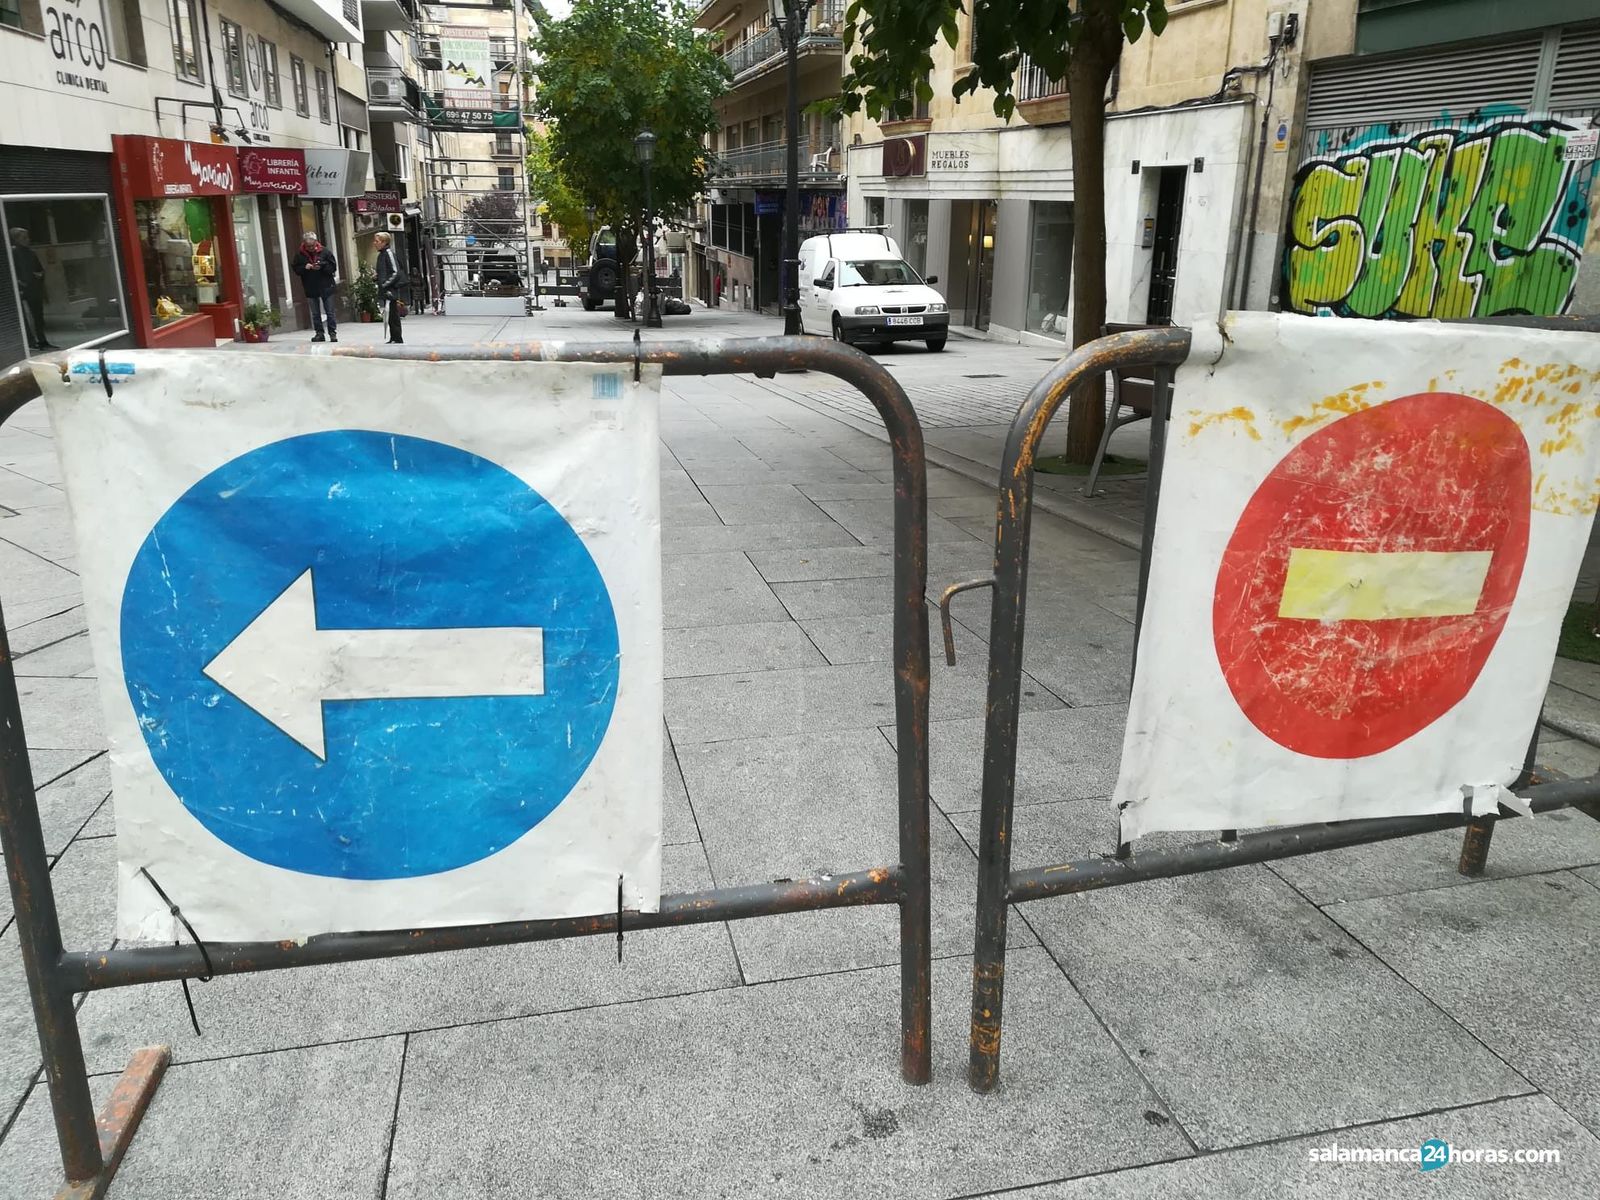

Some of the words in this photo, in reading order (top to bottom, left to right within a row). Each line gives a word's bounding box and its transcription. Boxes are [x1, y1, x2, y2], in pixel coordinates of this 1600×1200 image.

[46, 6, 105, 71] arco
[249, 101, 269, 131] arco
[461, 111, 471, 119] 47
[472, 112, 482, 120] 50
[483, 112, 493, 120] 75
[931, 150, 970, 159] MUEBLES
[931, 160, 969, 169] REGALOS
[267, 167, 301, 176] INFANTIL
